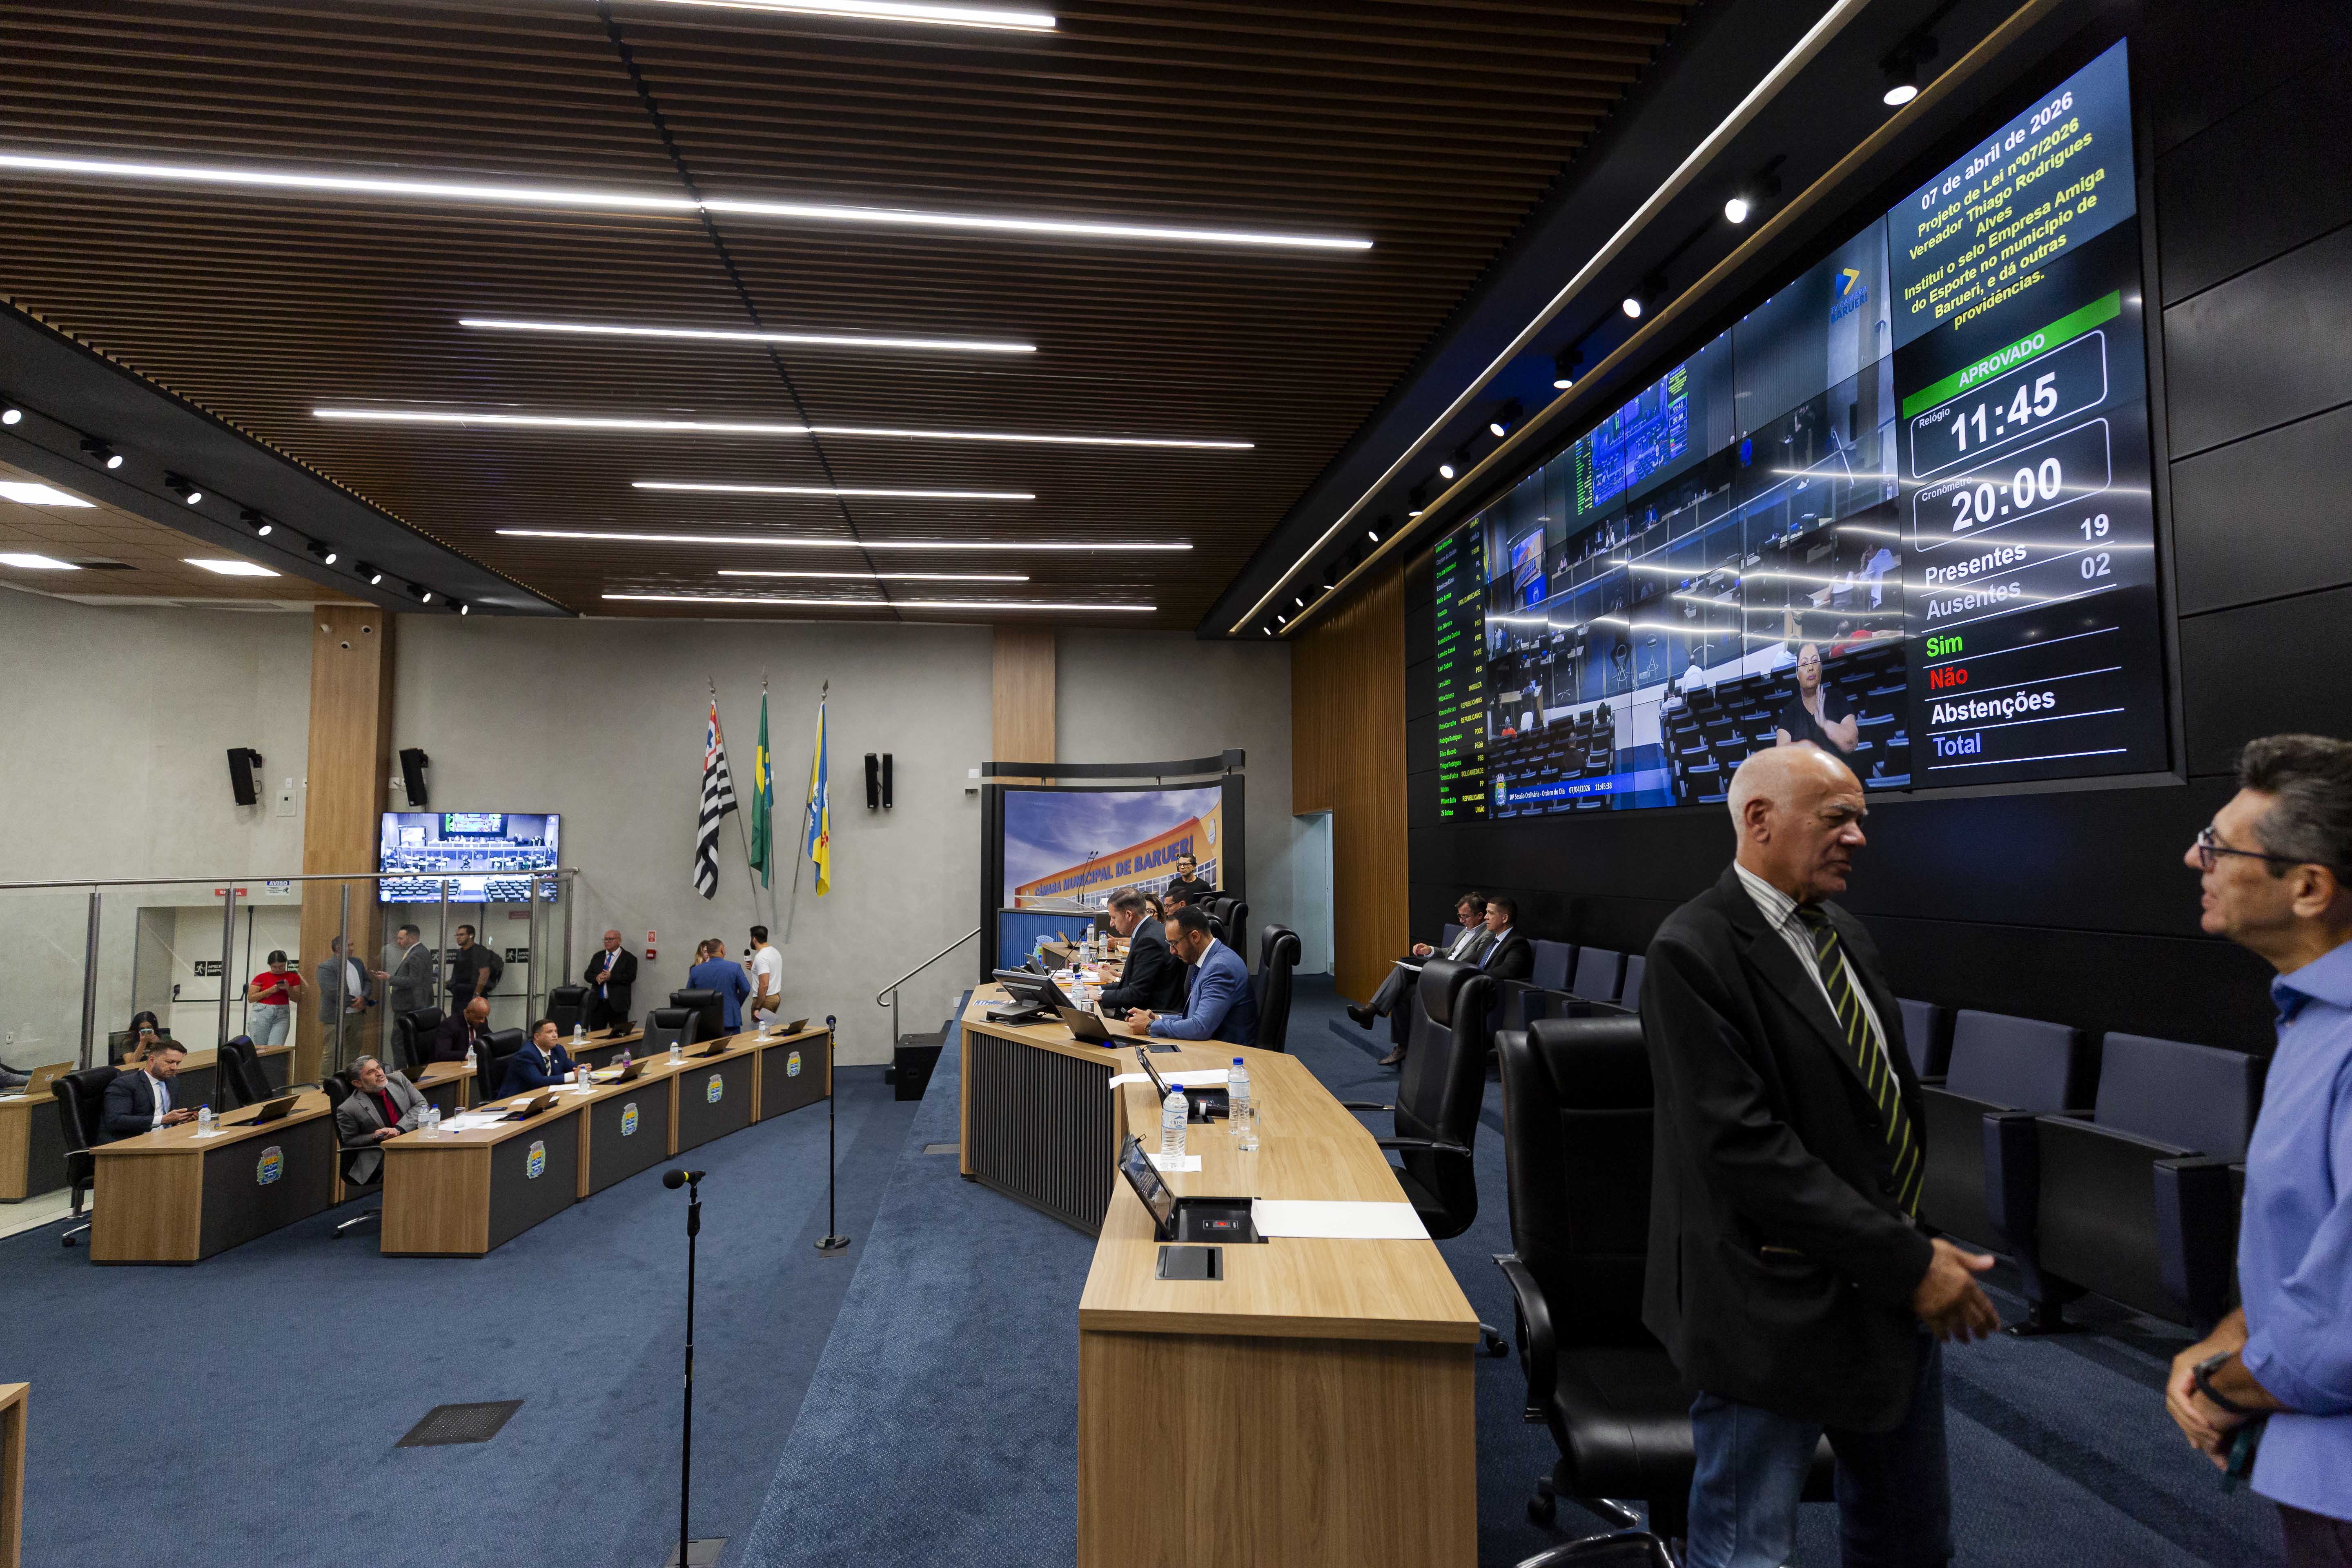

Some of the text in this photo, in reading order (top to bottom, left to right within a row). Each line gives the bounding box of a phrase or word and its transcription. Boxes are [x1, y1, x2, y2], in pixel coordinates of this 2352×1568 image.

[1921, 91, 2073, 210] 07 de abril de 2026
[1909, 133, 2093, 260] Vereador Thiago Rodrigues
[1918, 202, 1961, 237] Projeto
[1964, 189, 1980, 205] de
[1983, 169, 2004, 193] Lei
[1904, 168, 2105, 300] Institui o selo Empresa Amiga
[1976, 206, 2013, 237] Alves
[1911, 195, 2097, 314] do Esporte no município de
[1935, 234, 2067, 318] Barueri, e dá outras
[1831, 292, 1868, 325] BARUERI
[1954, 271, 2045, 331] providências.
[1959, 334, 2045, 388] APROVADO
[1919, 408, 1950, 428] Relógio
[1951, 371, 2058, 452] 11:45
[1922, 475, 1972, 502] Cronômetro
[1951, 457, 2062, 532] 20:00
[1470, 518, 1479, 528] UNIÃO
[2080, 513, 2109, 541] 19
[1470, 532, 1479, 542] UNIÃO
[1471, 546, 1479, 556] PSDB
[1925, 543, 2027, 587] Presentes
[2081, 552, 2111, 579] 02
[1458, 589, 1481, 606] SOLIDARIEDADE
[1927, 581, 2021, 620] Ausentes
[1473, 648, 1482, 657] PODE
[1927, 635, 1963, 657] Sim
[1469, 681, 1482, 691] MOBILIZA
[1930, 666, 1968, 690] Não
[1461, 697, 1482, 709] REPUBLICANOS
[1931, 690, 2055, 725] Abstenções
[1461, 712, 1483, 723] REPUBLICANOS
[1933, 733, 1981, 757] Total
[1461, 767, 1484, 777] SOLIDARIEDADE
[1462, 793, 1484, 802] REPUBLICANOS
[1569, 784, 1590, 794] 07/04/2026
[1595, 782, 1613, 791] 11:45:38
[1475, 805, 1485, 813] UNIÃO
[1063, 864, 1113, 891] MUNICIPAL
[1116, 859, 1131, 878] DE
[1134, 835, 1193, 873] BARUERI
